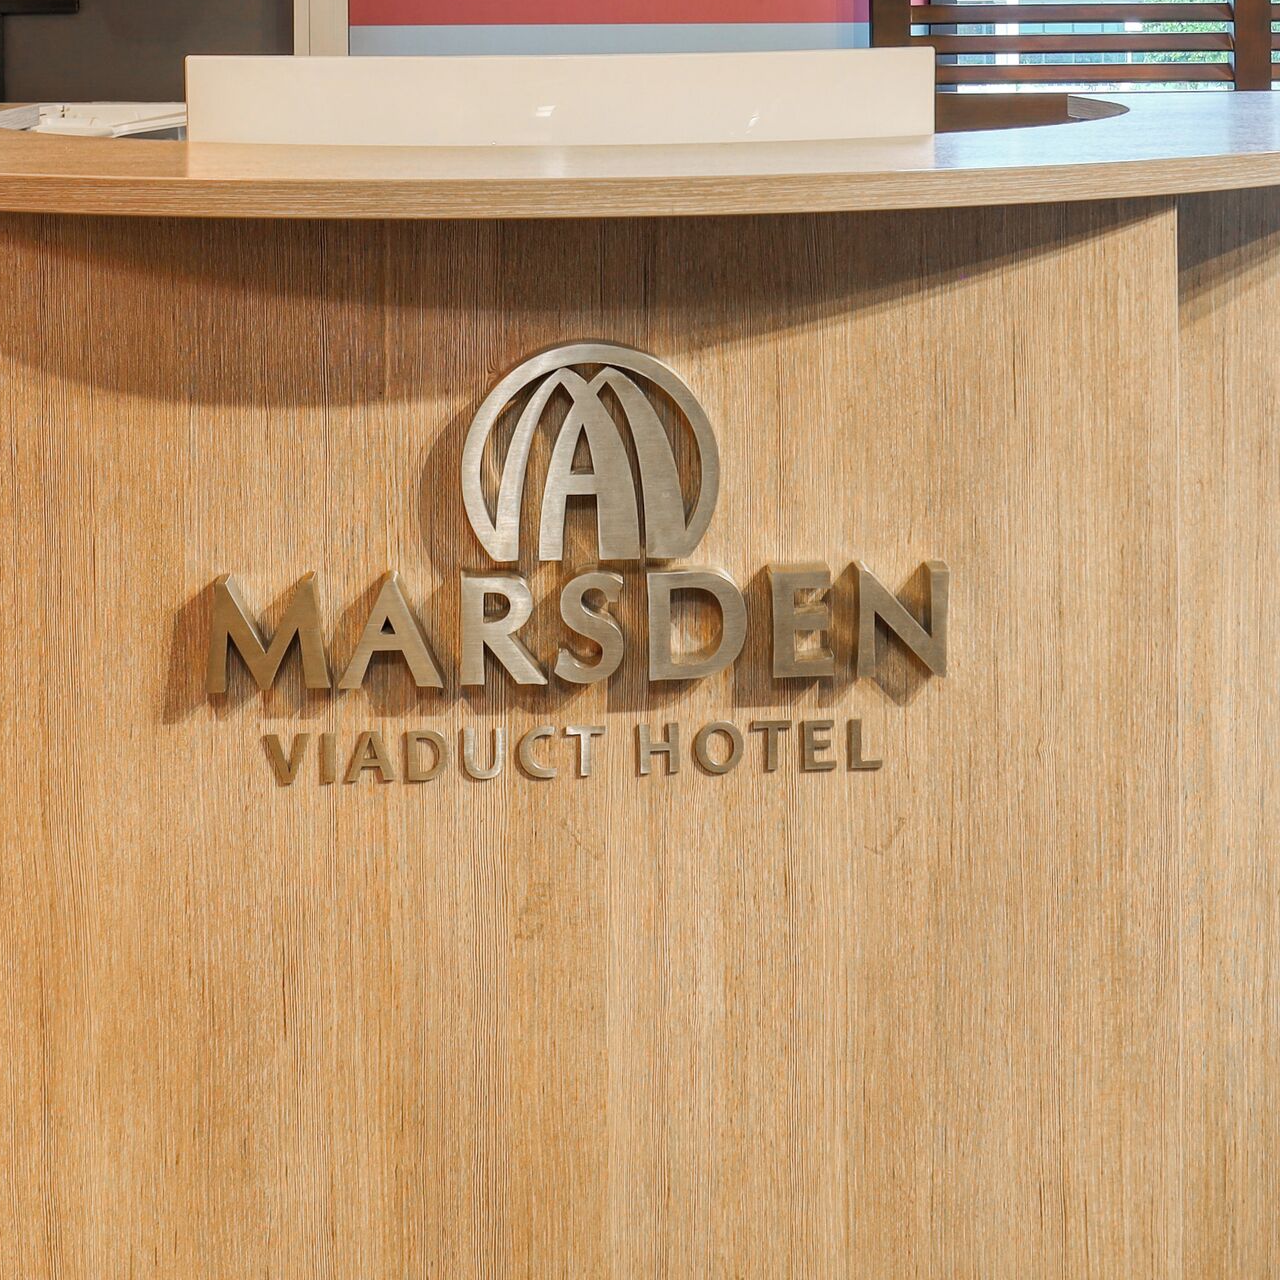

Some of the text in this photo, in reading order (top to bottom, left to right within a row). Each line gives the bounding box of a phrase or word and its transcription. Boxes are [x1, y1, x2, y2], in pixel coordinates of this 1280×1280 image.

[206, 559, 951, 694] MARSDEN
[263, 718, 884, 786] VIADUCT HOTEL
